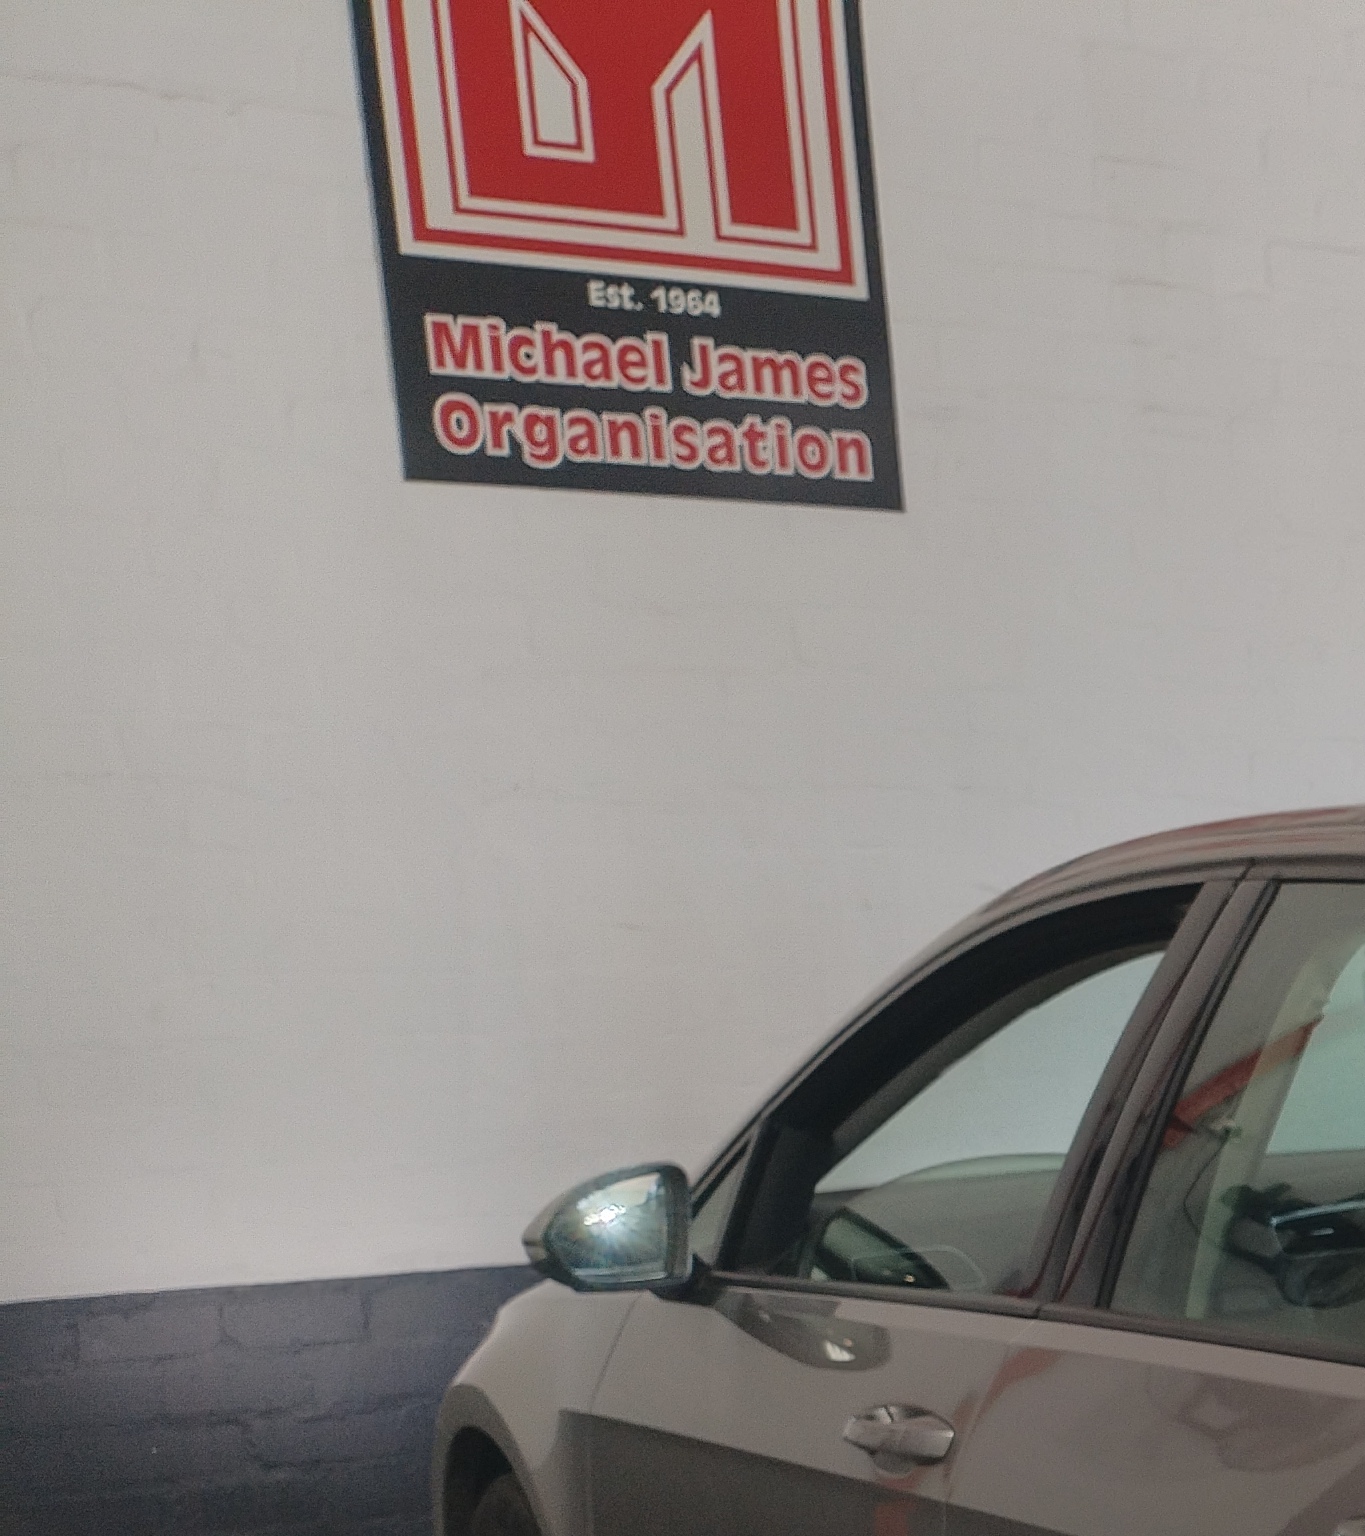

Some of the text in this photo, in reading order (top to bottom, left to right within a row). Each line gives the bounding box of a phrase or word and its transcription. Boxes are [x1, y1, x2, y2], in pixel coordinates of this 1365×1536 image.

[587, 279, 722, 317] Est. 1964
[424, 313, 868, 409] Michael James
[432, 392, 874, 480] Organisation
